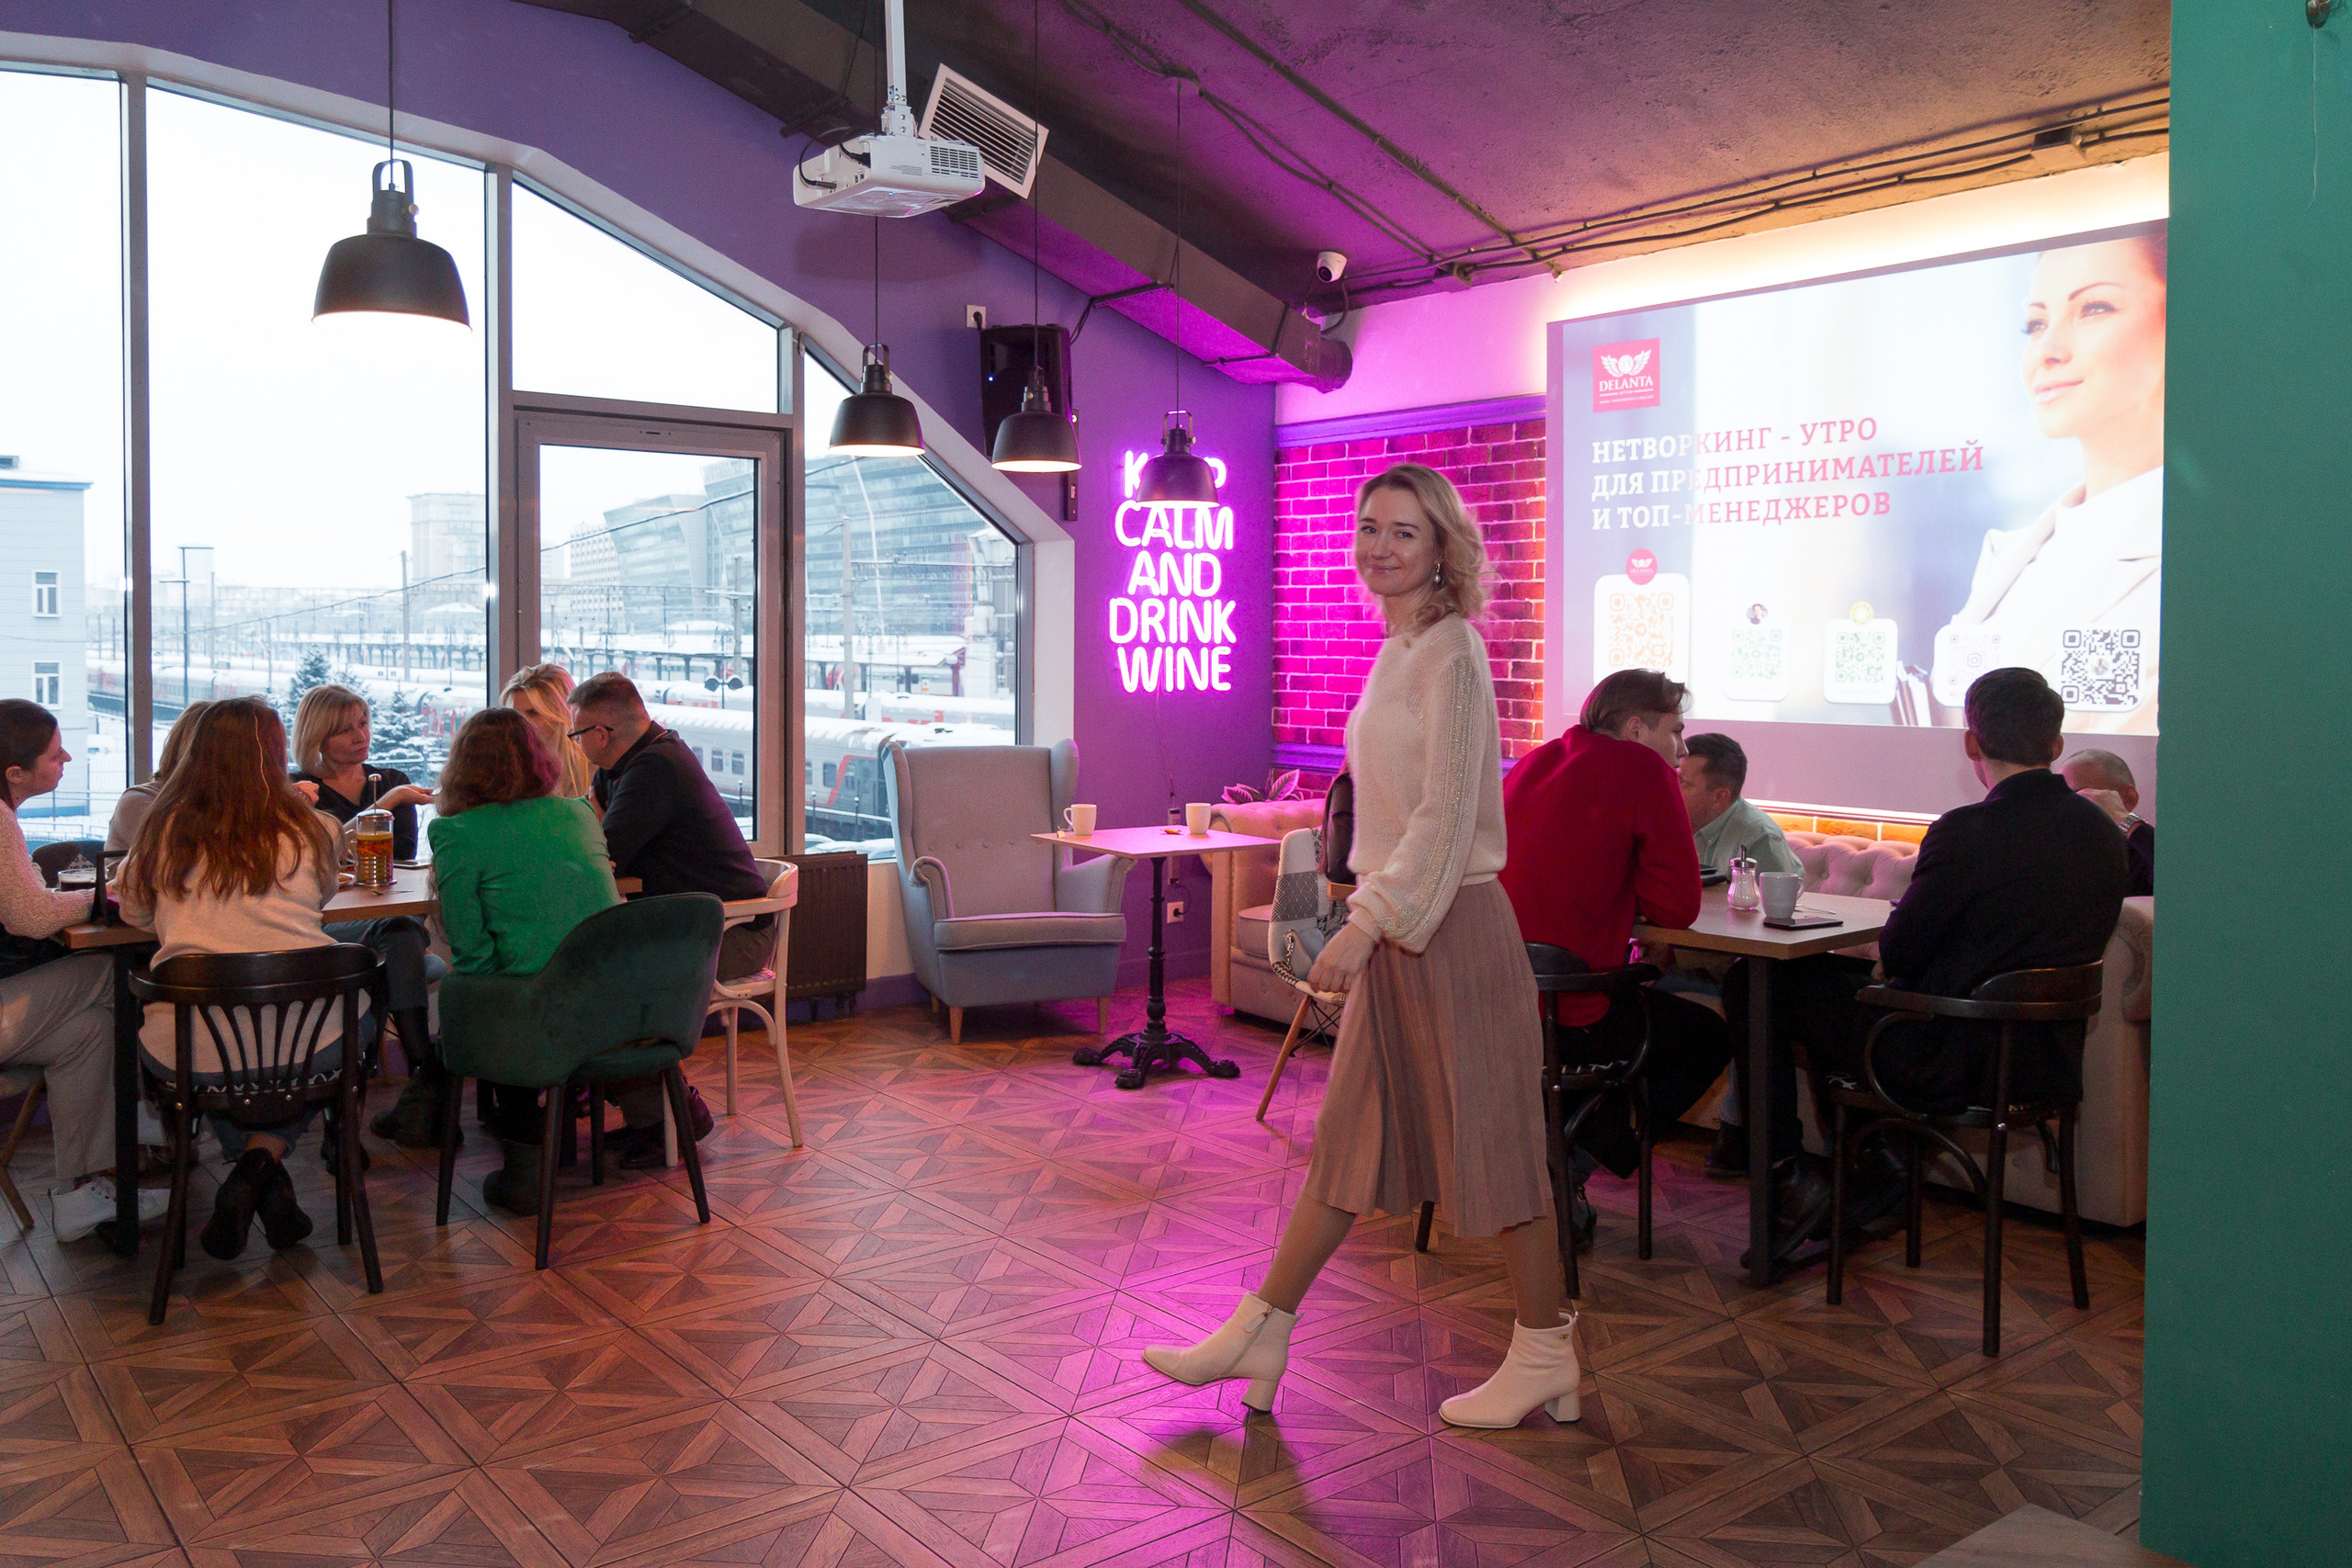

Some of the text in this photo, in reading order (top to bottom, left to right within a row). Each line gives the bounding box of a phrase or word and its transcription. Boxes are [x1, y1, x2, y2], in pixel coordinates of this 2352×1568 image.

[1599, 376, 1654, 392] DELANTA
[1592, 427, 1771, 463] НЕТВОРКИНГ
[1800, 417, 1877, 446] УТРО
[1591, 439, 1984, 502] ДЛЯ ПРЕДПРИНИМАТЕЛЕЙ
[1114, 500, 1234, 550] CALM
[1592, 491, 1891, 530] И ТОП-МЕНЕДЖЕРОВ
[1127, 550, 1222, 598] AND
[1109, 597, 1237, 644] DRINK
[1117, 646, 1231, 693] WINE
